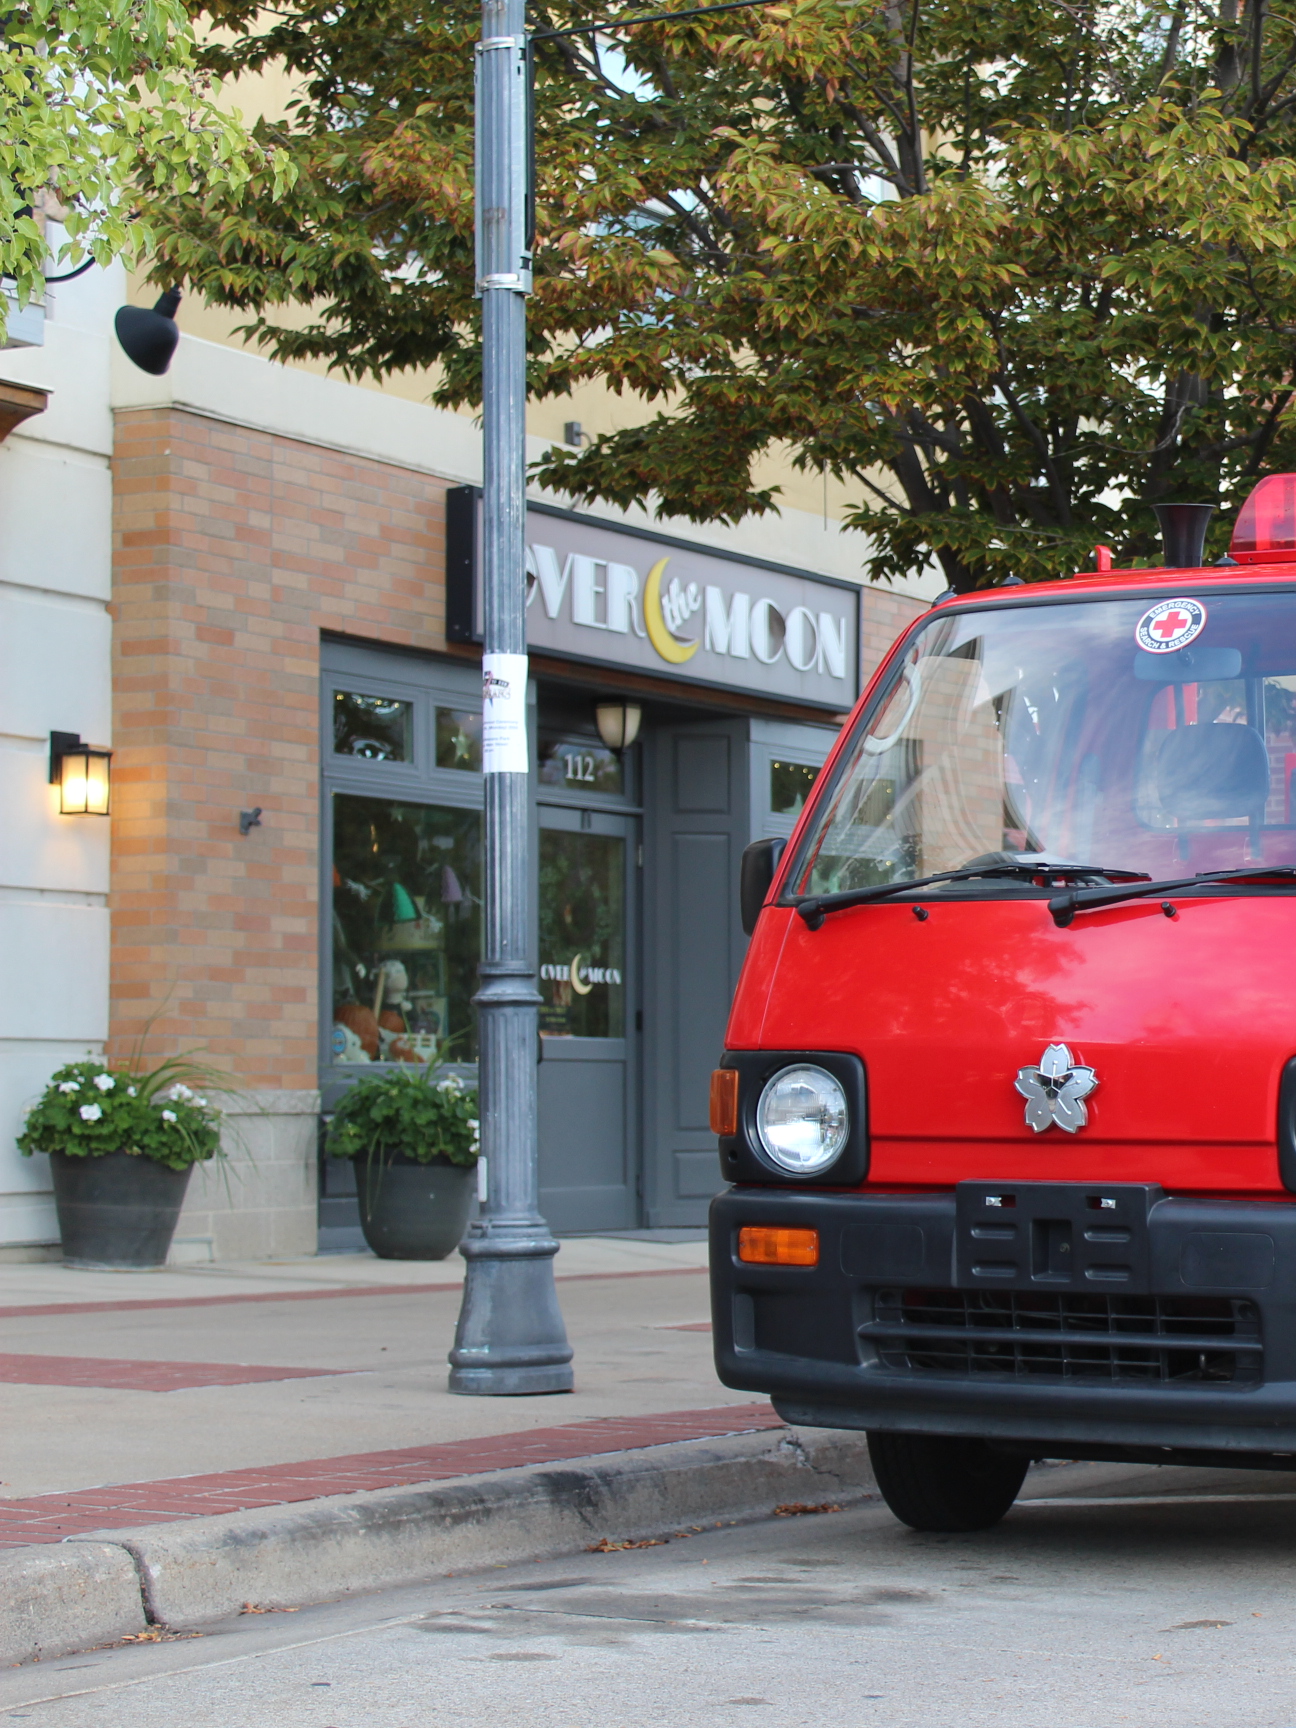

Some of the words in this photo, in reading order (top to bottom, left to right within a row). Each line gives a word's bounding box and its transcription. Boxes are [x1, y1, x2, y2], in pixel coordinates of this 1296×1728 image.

[1149, 601, 1200, 618] EMERGENCY
[660, 577, 702, 633] the
[704, 585, 847, 680] MOON
[1140, 627, 1160, 649] SEARCH
[1168, 624, 1199, 648] RESCUE
[564, 753, 595, 782] 112
[540, 963, 570, 981] OVER
[588, 966, 622, 985] MOON
